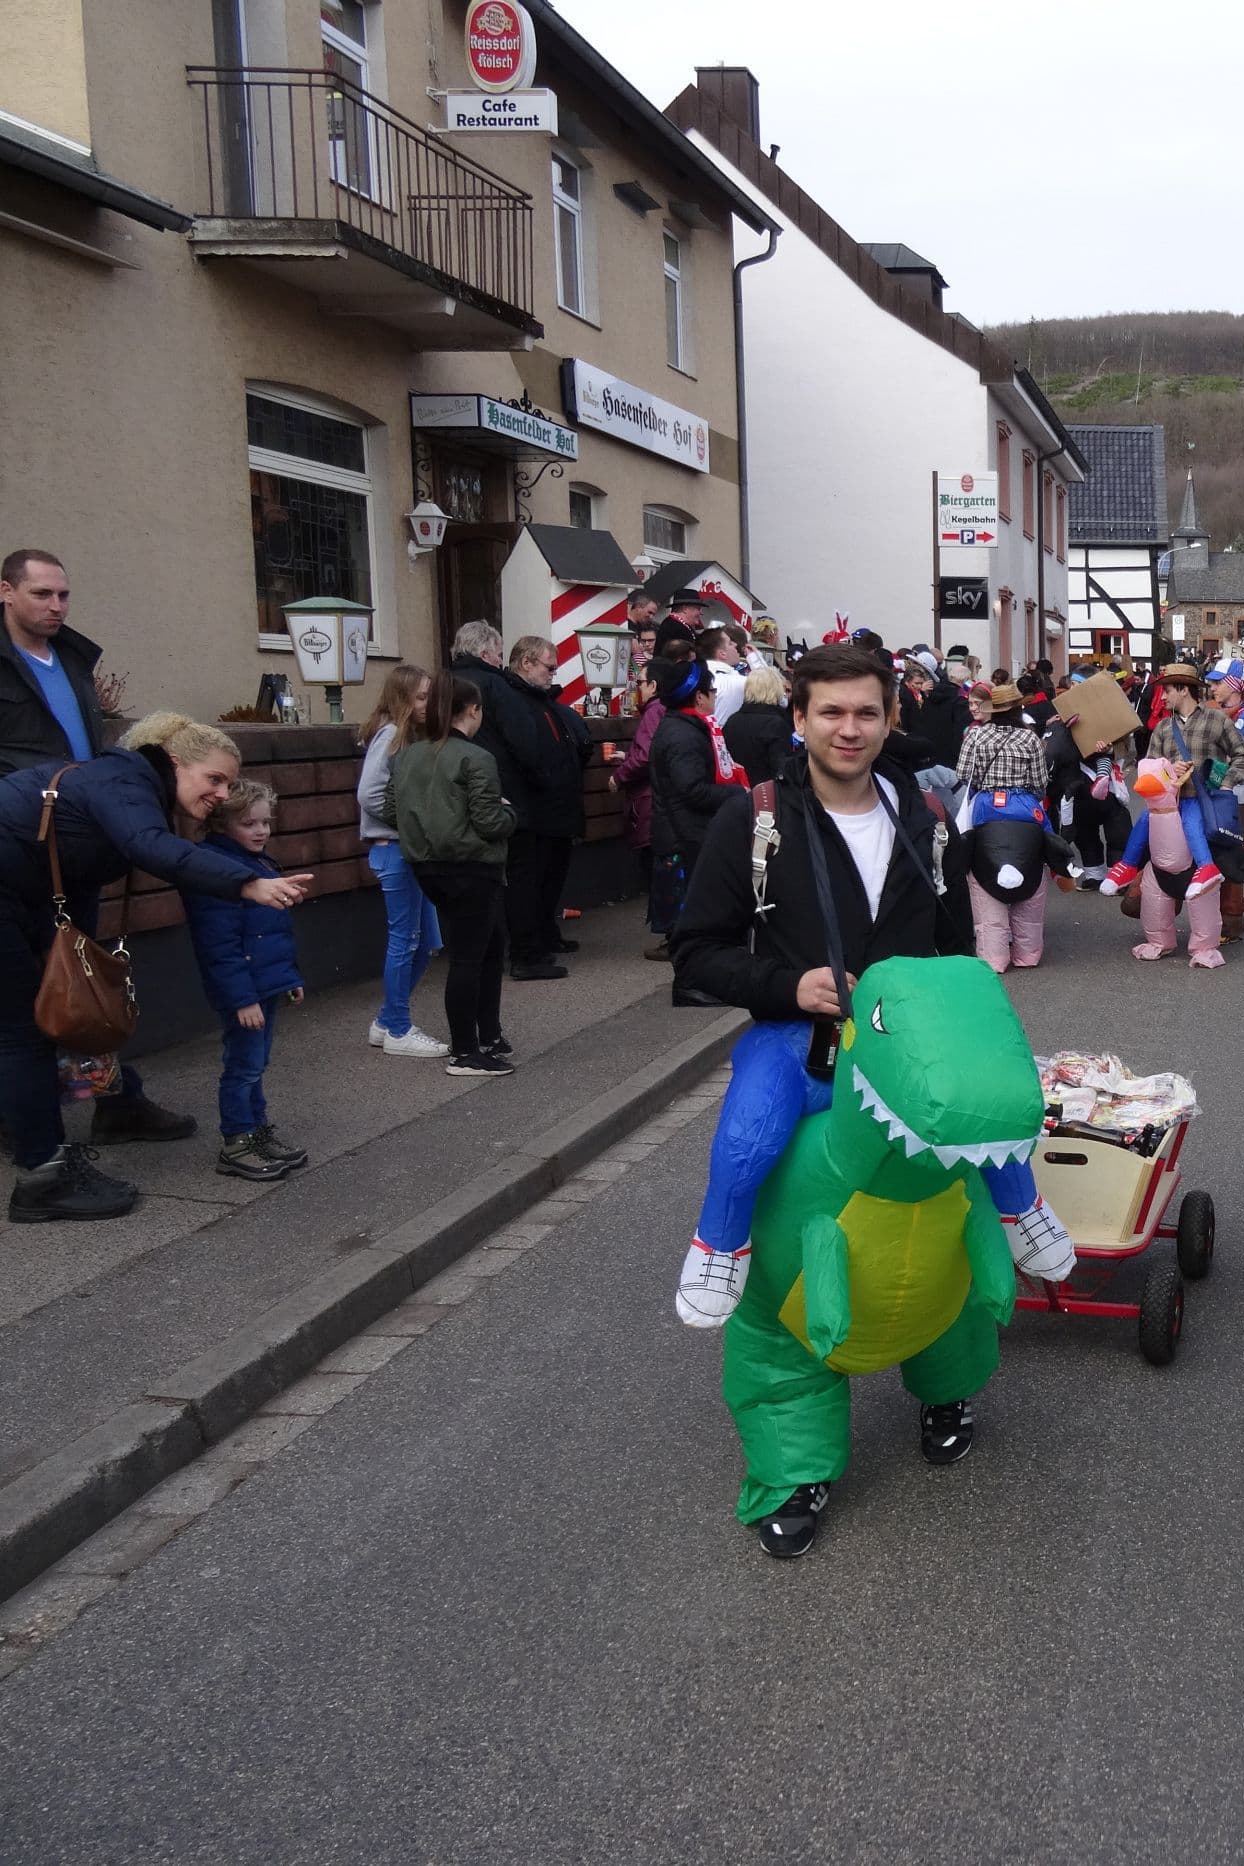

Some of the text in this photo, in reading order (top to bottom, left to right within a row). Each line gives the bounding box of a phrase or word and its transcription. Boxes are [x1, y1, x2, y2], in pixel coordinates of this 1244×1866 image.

[470, 35, 520, 50] Reissdorf
[478, 53, 513, 69] Kölsch
[482, 99, 517, 112] Cafe
[456, 113, 540, 126] Restaurant
[487, 401, 576, 453] Hasenfelder Hof
[602, 387, 668, 438] Hasenfelder
[673, 420, 692, 454] Hof
[940, 494, 996, 508] Biergarten
[951, 515, 996, 524] Kegelbahn
[945, 586, 982, 609] sky
